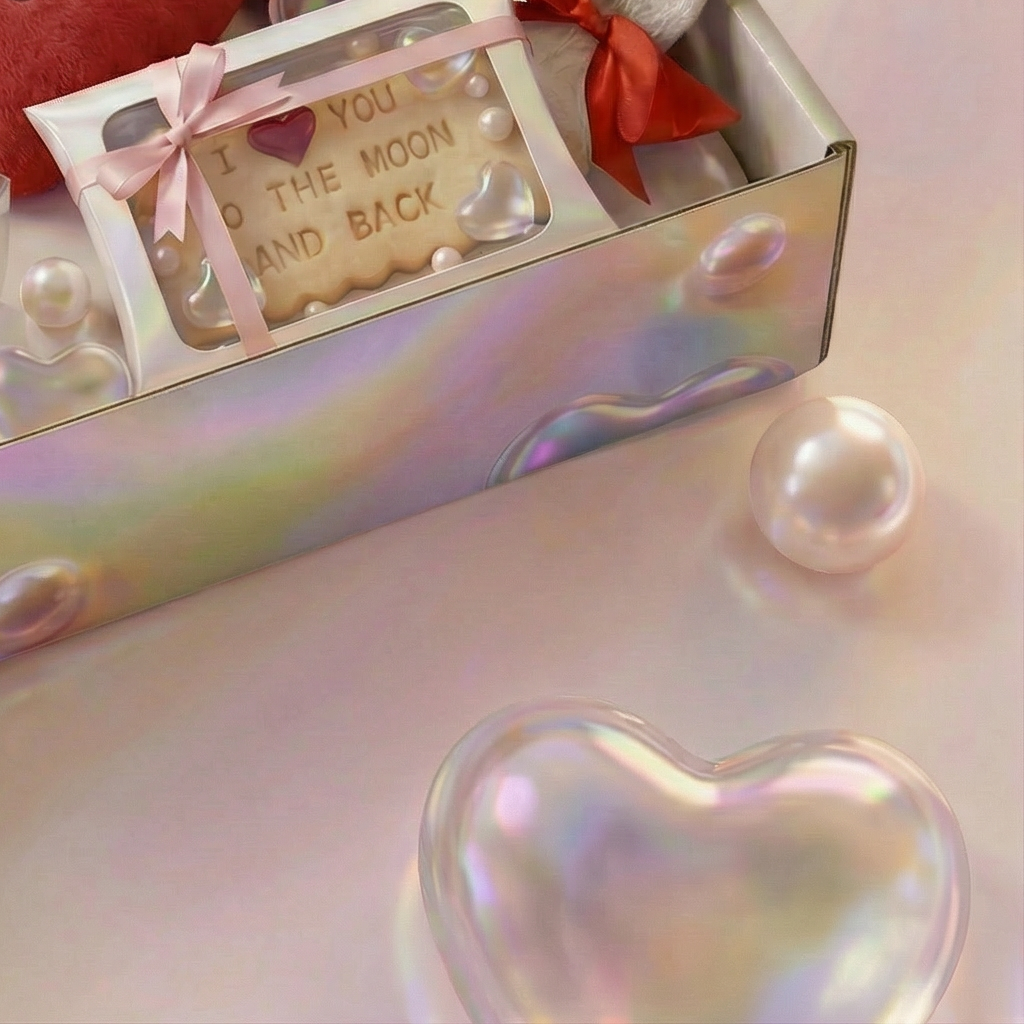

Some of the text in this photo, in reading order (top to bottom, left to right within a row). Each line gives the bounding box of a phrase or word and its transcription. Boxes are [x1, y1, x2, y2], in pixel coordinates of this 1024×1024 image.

[211, 83, 397, 176] I YOU
[266, 161, 342, 213] THE
[359, 118, 456, 179] MOON
[254, 181, 446, 277] AND BACK
